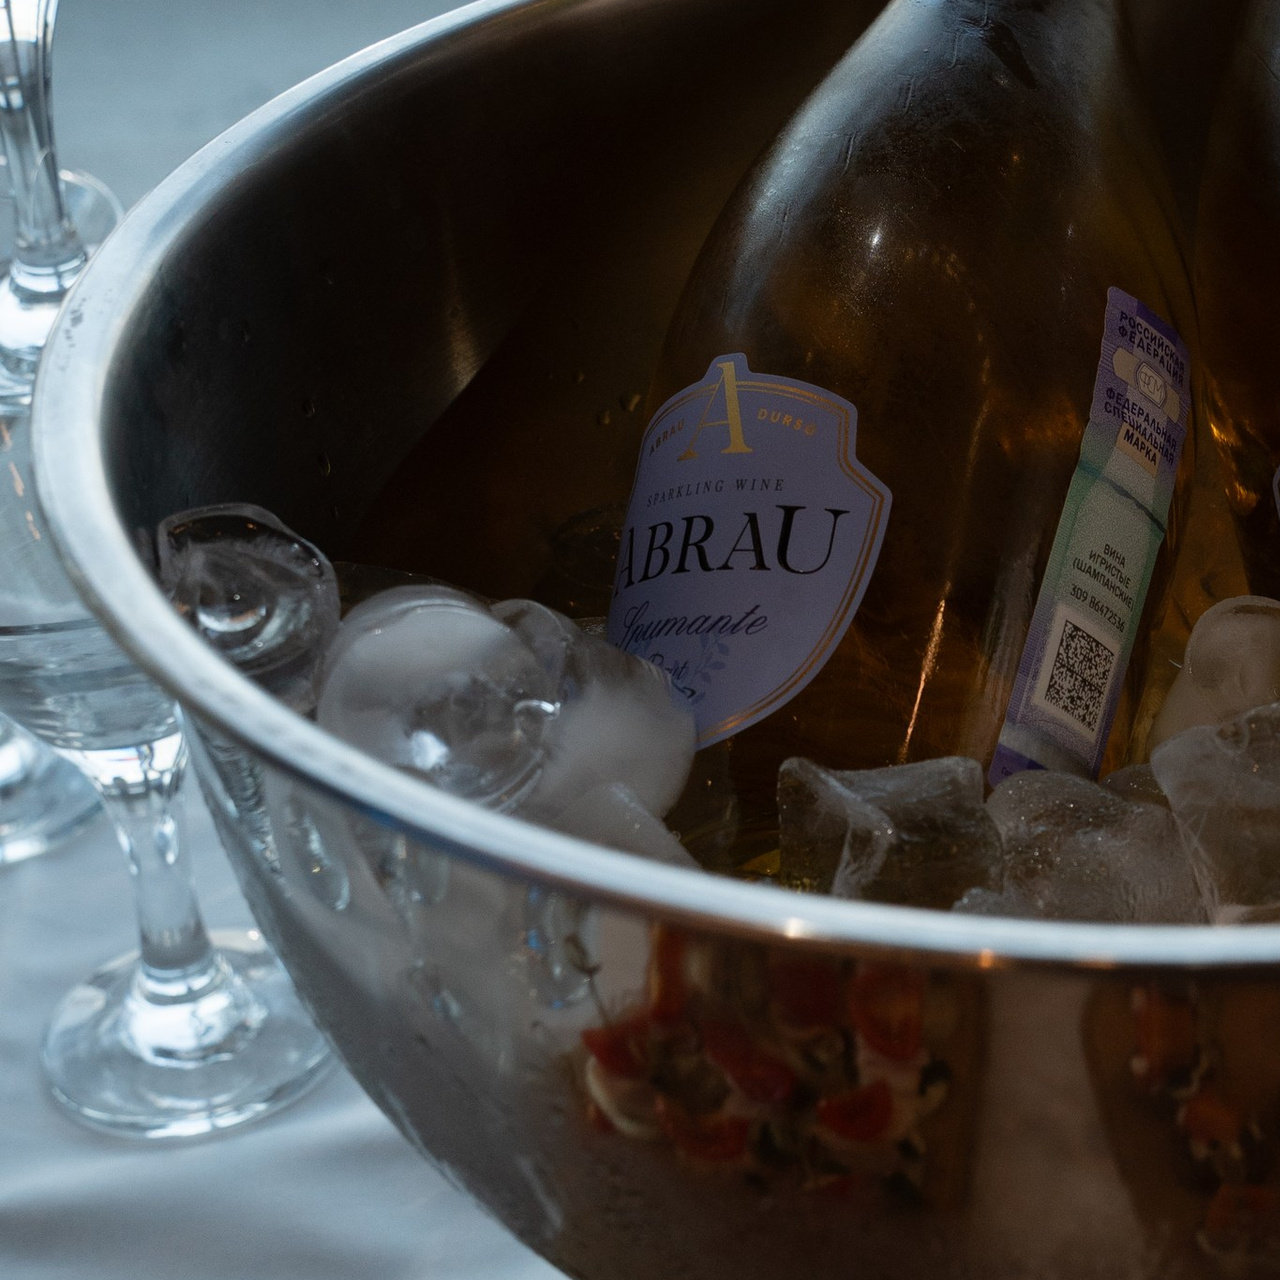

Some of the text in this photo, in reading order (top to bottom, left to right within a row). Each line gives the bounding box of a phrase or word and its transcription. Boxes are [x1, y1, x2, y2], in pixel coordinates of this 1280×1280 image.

[1117, 324, 1184, 388] ФЕДЕРАЦИЯ
[1119, 310, 1185, 375] РОССИЙСКАЯ
[648, 407, 817, 456] ABRAU DURSO
[677, 360, 755, 462] A
[1103, 401, 1175, 467] СПЕЦИАЛЬНАЯ
[1105, 386, 1178, 453] ФЕДЕРАЛЬНАЯ
[1123, 428, 1158, 467] МАРКА
[646, 477, 786, 508] SPARKLING WINE
[614, 505, 850, 599] ABRAU
[1088, 550, 1132, 589] ИГРИСТЫЕ
[1103, 543, 1126, 569] ВИНА
[1070, 583, 1089, 603] 309
[1072, 557, 1134, 612] (ШАМПАНСКИЕ)
[616, 601, 769, 652] Spumante
